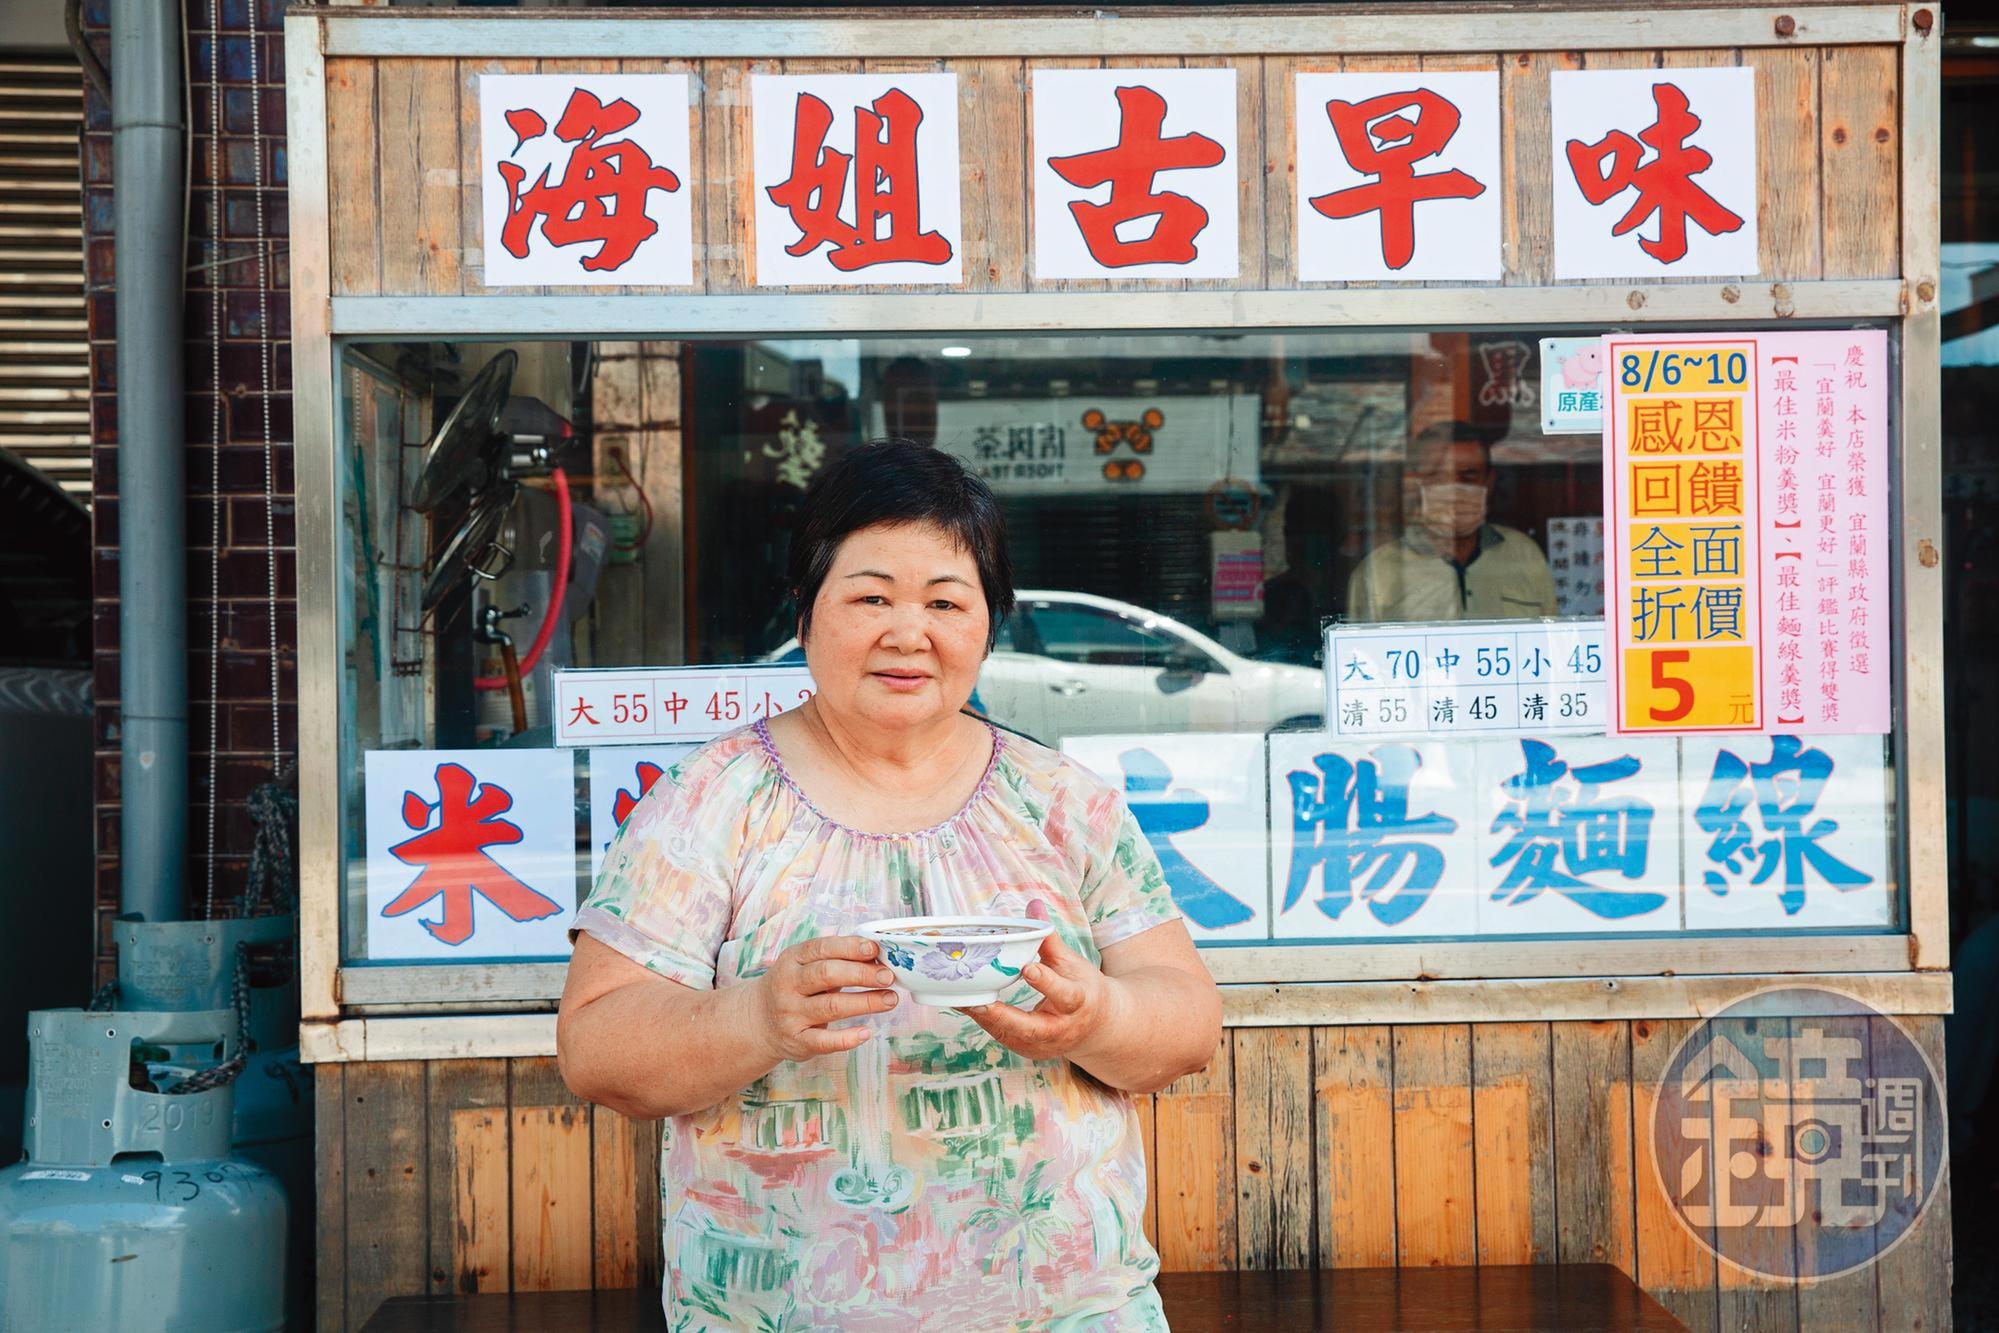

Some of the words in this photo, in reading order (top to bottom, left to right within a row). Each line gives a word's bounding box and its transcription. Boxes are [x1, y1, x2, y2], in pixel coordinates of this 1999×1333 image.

[497, 83, 1745, 272] 海姐古早味
[1621, 349, 1748, 392] 8/6~10
[1844, 344, 1868, 389] 慶祝
[1557, 390, 1602, 414] 原產
[1630, 399, 1741, 453] 感恩
[1846, 404, 1869, 497] 本店榮獲
[1633, 461, 1742, 517] 回饋
[1631, 524, 1742, 577] 全面
[1632, 586, 1743, 641] 折價
[1847, 513, 1871, 675] 宜蘭縣政府徵選
[1343, 653, 1374, 682] 大
[1386, 648, 1420, 681] 70
[1435, 646, 1460, 680] 中
[1476, 646, 1511, 677] 55
[1522, 646, 1552, 678] 小
[1567, 643, 1602, 674] 45
[1649, 650, 1696, 722] 5
[1728, 694, 1754, 724] 元
[567, 696, 600, 726] 大
[613, 693, 648, 723] 55
[664, 691, 689, 724] 中
[705, 690, 741, 721] 45
[1342, 698, 1368, 727] 清
[1379, 698, 1407, 722] 55
[1433, 697, 1459, 724] 清
[1469, 695, 1498, 720] 45
[1523, 692, 1549, 721] 清
[1560, 693, 1588, 717] 35
